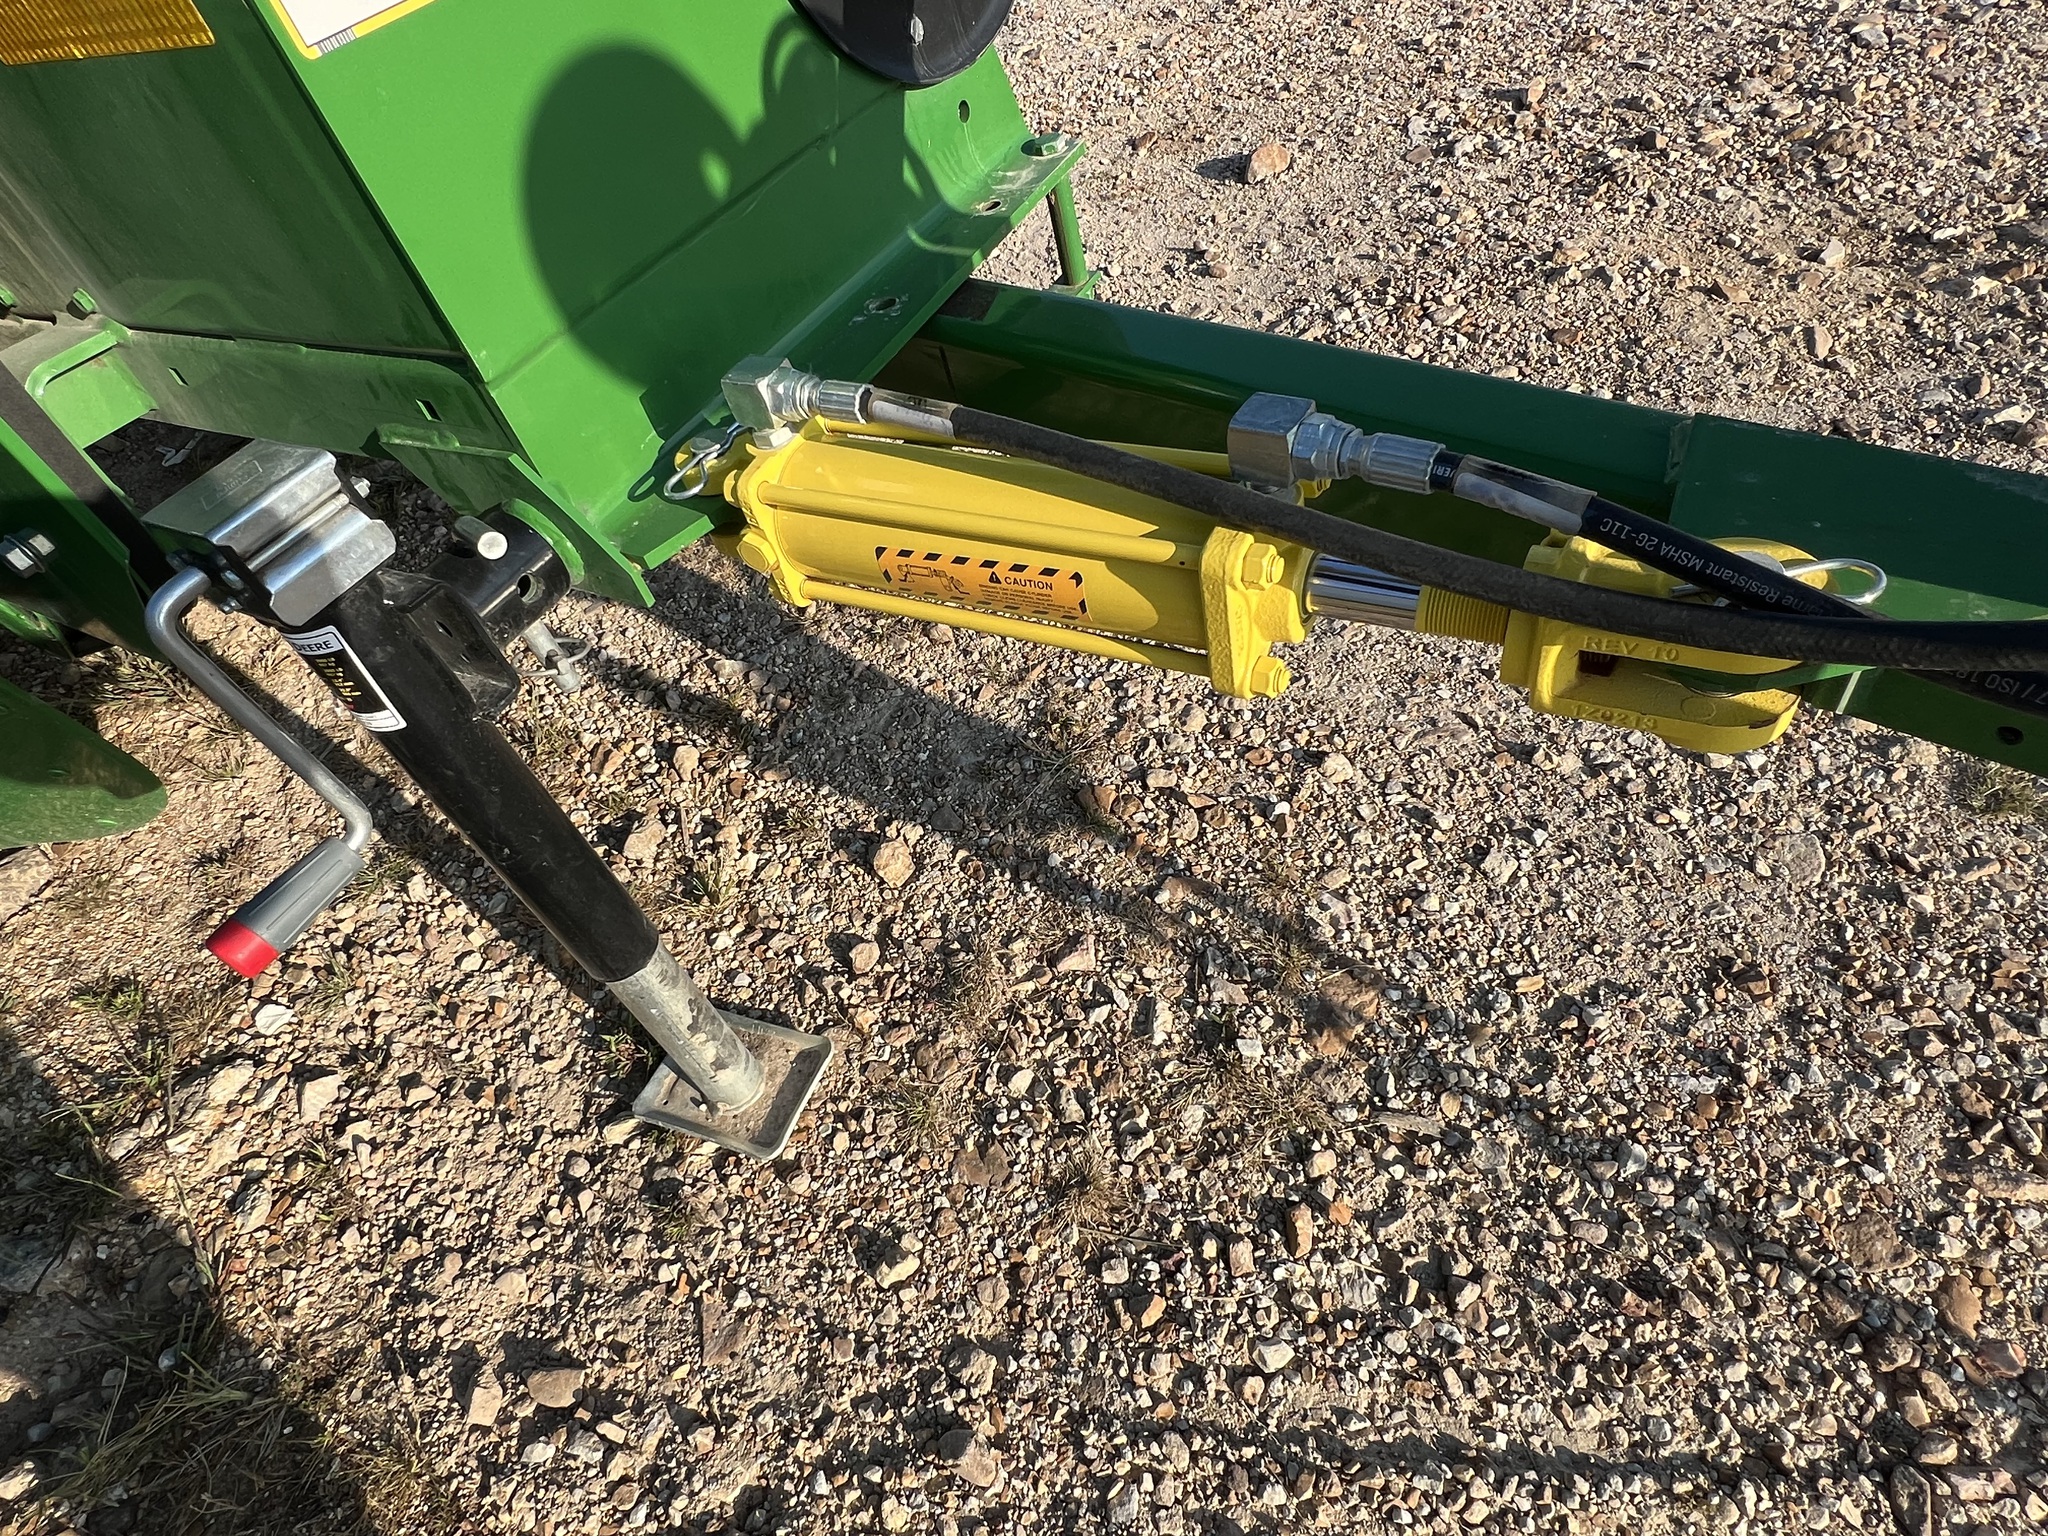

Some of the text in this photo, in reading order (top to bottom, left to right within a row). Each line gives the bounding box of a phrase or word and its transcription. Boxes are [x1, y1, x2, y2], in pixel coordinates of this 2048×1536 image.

[1599, 518, 1659, 551] 2G-11C
[1660, 541, 1705, 571] MSHA
[1004, 576, 1054, 591] CAUTION
[1705, 561, 1781, 603] Resistant
[292, 640, 334, 653] DEERE
[1583, 635, 1680, 661] REV 10
[1984, 673, 2020, 695] ISO
